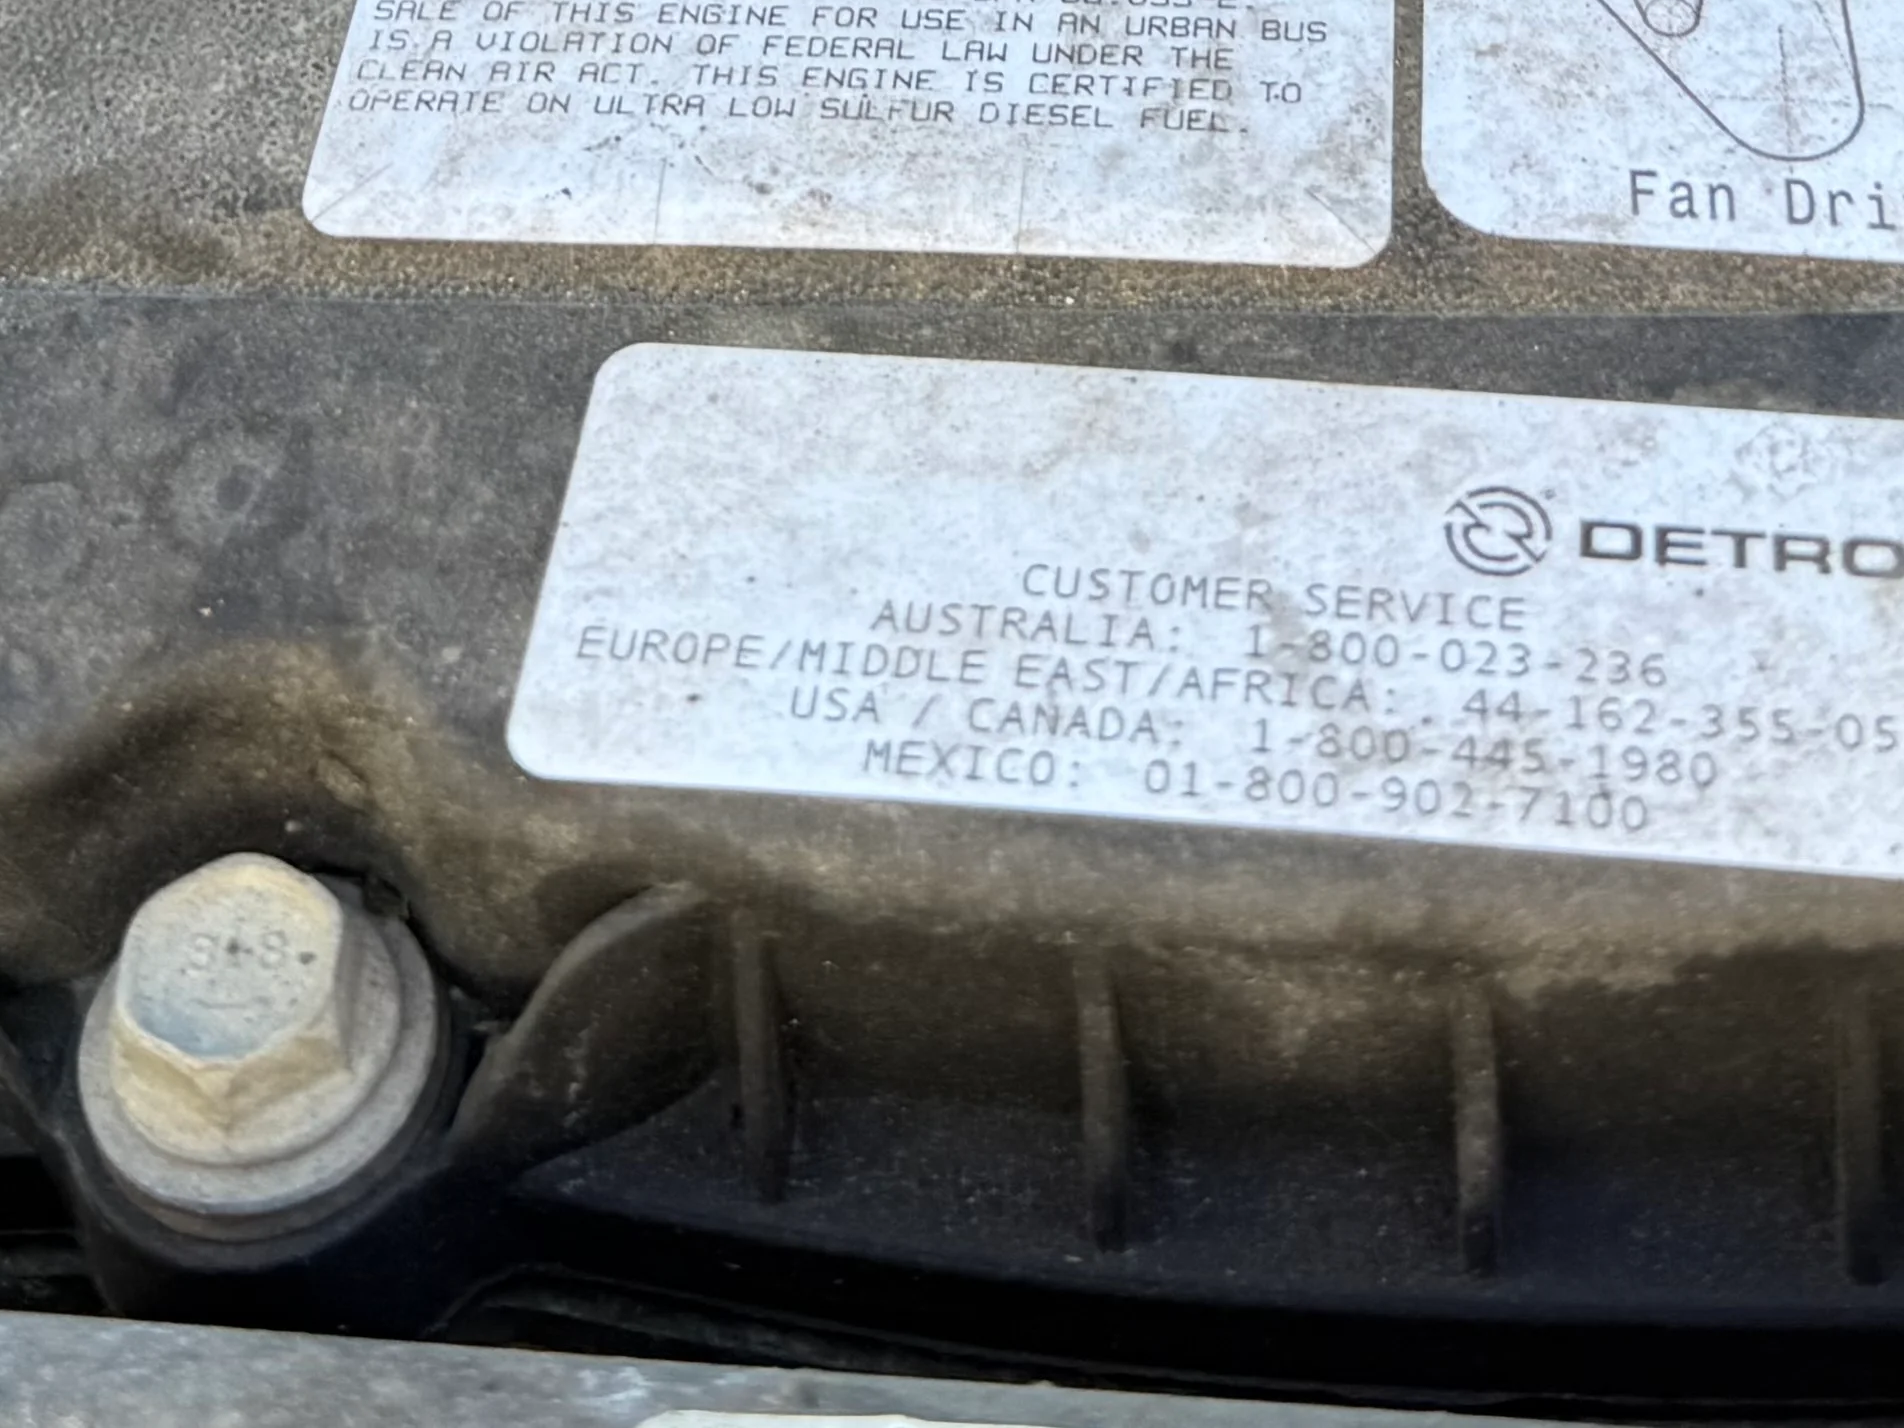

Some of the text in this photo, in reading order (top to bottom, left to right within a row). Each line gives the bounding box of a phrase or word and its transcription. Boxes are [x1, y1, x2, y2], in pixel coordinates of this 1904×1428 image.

[369, 29, 1234, 72] IS A VIOLATION OF FEDERAL LAW UNDER THE
[483, 0, 525, 23] OF
[553, 1, 635, 25] THIS
[657, 3, 789, 27] ENGINE
[811, 5, 878, 29] FOR
[901, 9, 966, 33] USE
[985, 10, 1034, 33] IN
[1057, 12, 1105, 37] AN
[1124, 15, 1237, 41] URBAN
[1261, 19, 1327, 44] BUS
[356, 59, 1302, 104] CLEAN AIR ACT. THIS ENGINE IS CERTIFIED TO
[348, 89, 1249, 136] OPERATE ON ULTRA LOW SULFUR DIESEL FUEL.
[1627, 168, 1738, 222] Fan
[1022, 563, 1527, 631] CUSTOMER SERVICE
[576, 623, 987, 685] EUROPE/MIDDLE
[1014, 655, 1399, 714] EAST/AFRICA:
[870, 598, 1668, 688] AUSTRALIA: 1-800-023-236
[789, 686, 1718, 789] USA / CANADA: 1-800-445-1980
[863, 739, 1649, 832] MEXICO: 01-800-902-7100
